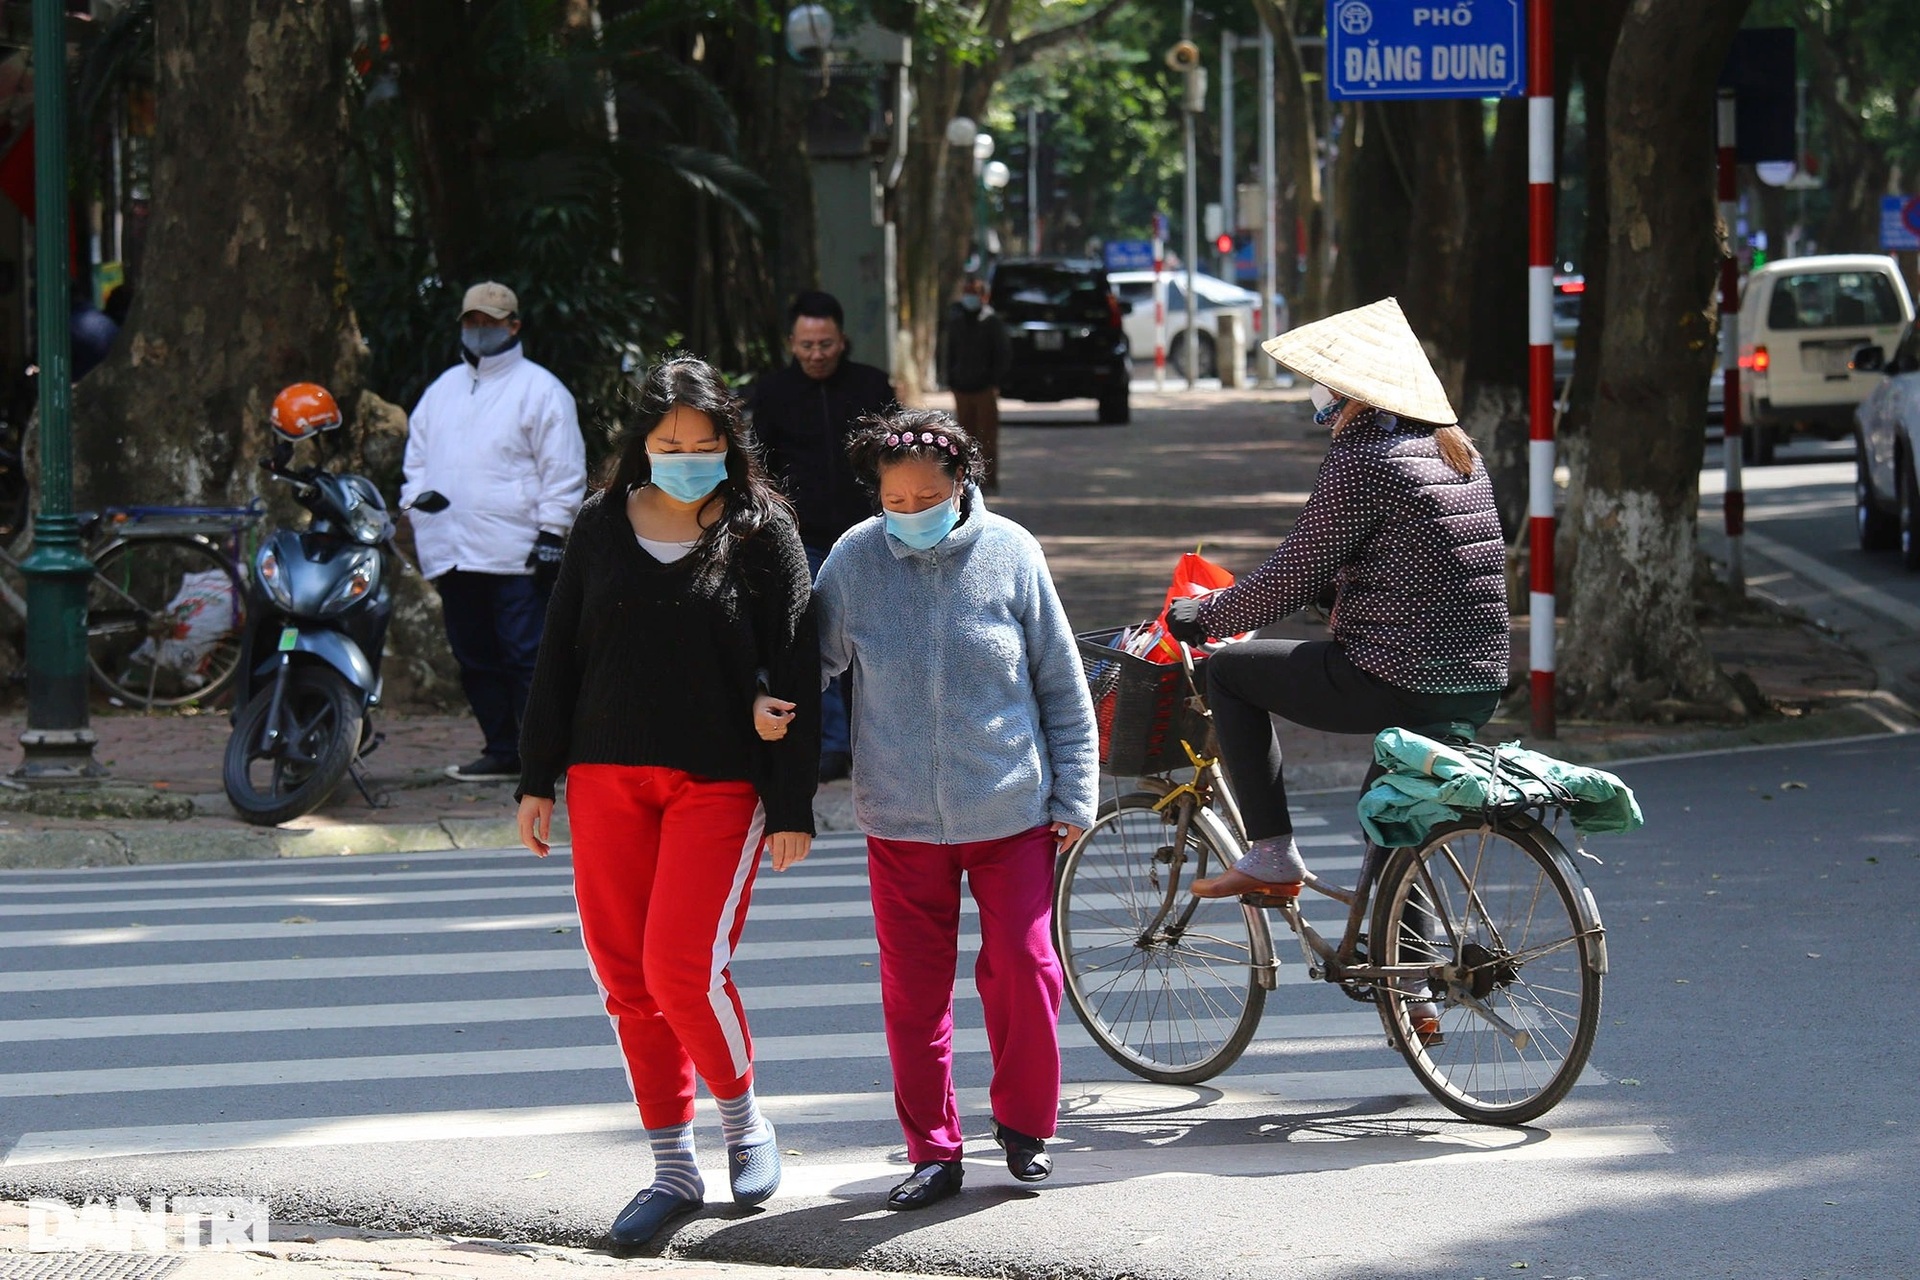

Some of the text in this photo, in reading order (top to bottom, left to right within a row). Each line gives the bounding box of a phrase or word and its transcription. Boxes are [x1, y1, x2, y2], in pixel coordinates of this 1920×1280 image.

[1413, 1, 1474, 26] PHỐ
[1345, 39, 1507, 88] ĐẶNG DUNG
